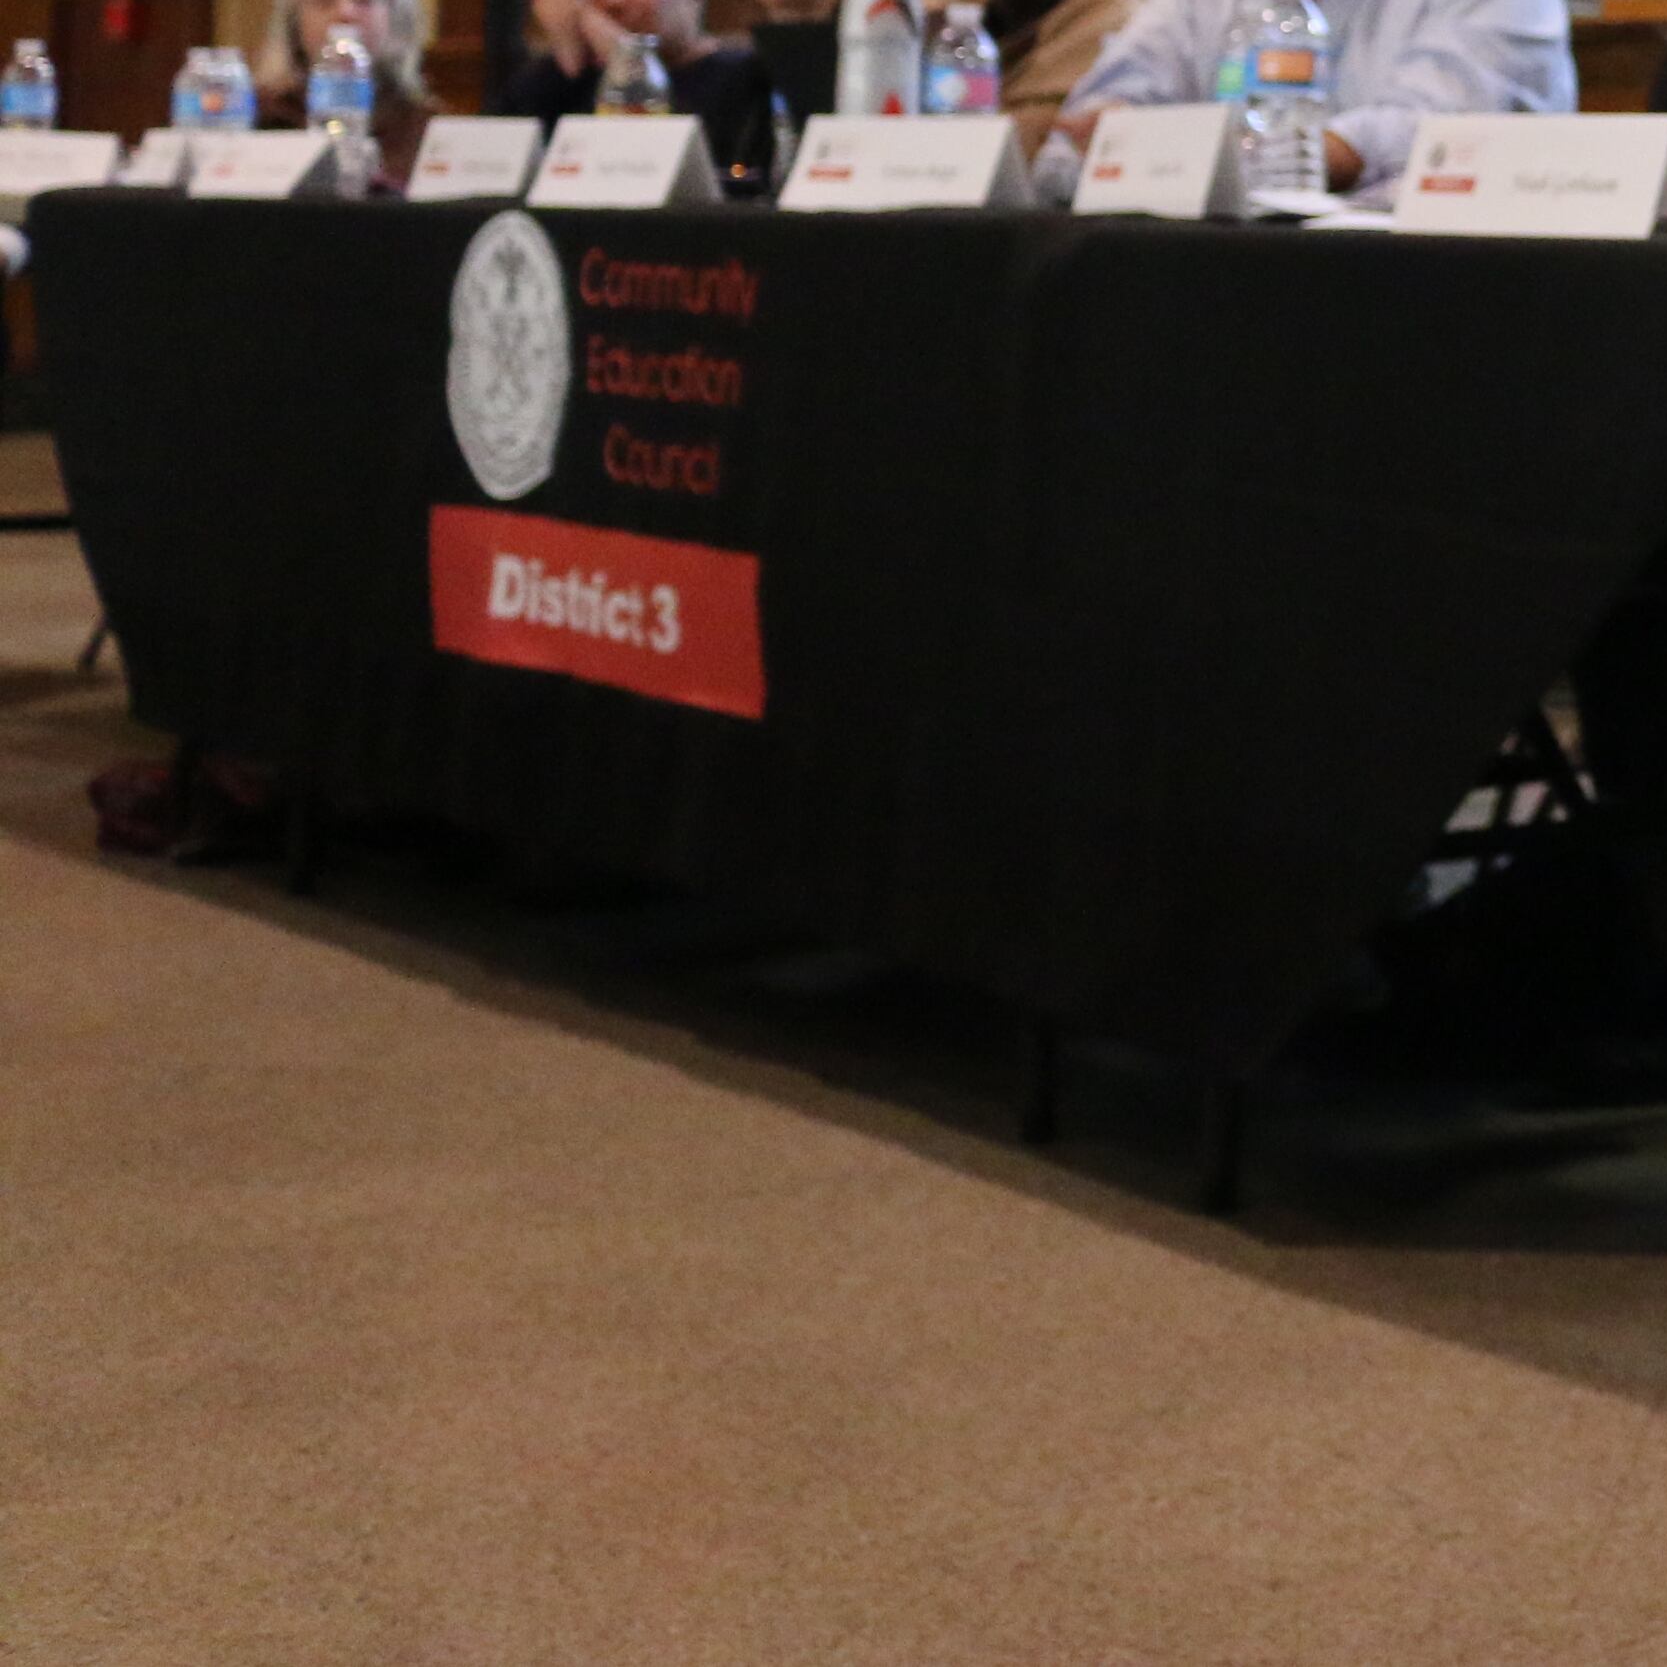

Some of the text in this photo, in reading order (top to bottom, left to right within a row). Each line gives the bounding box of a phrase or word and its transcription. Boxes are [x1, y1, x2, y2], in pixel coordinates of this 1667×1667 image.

[579, 245, 759, 323] Community
[586, 333, 744, 406] Education
[488, 552, 681, 655] District 3
